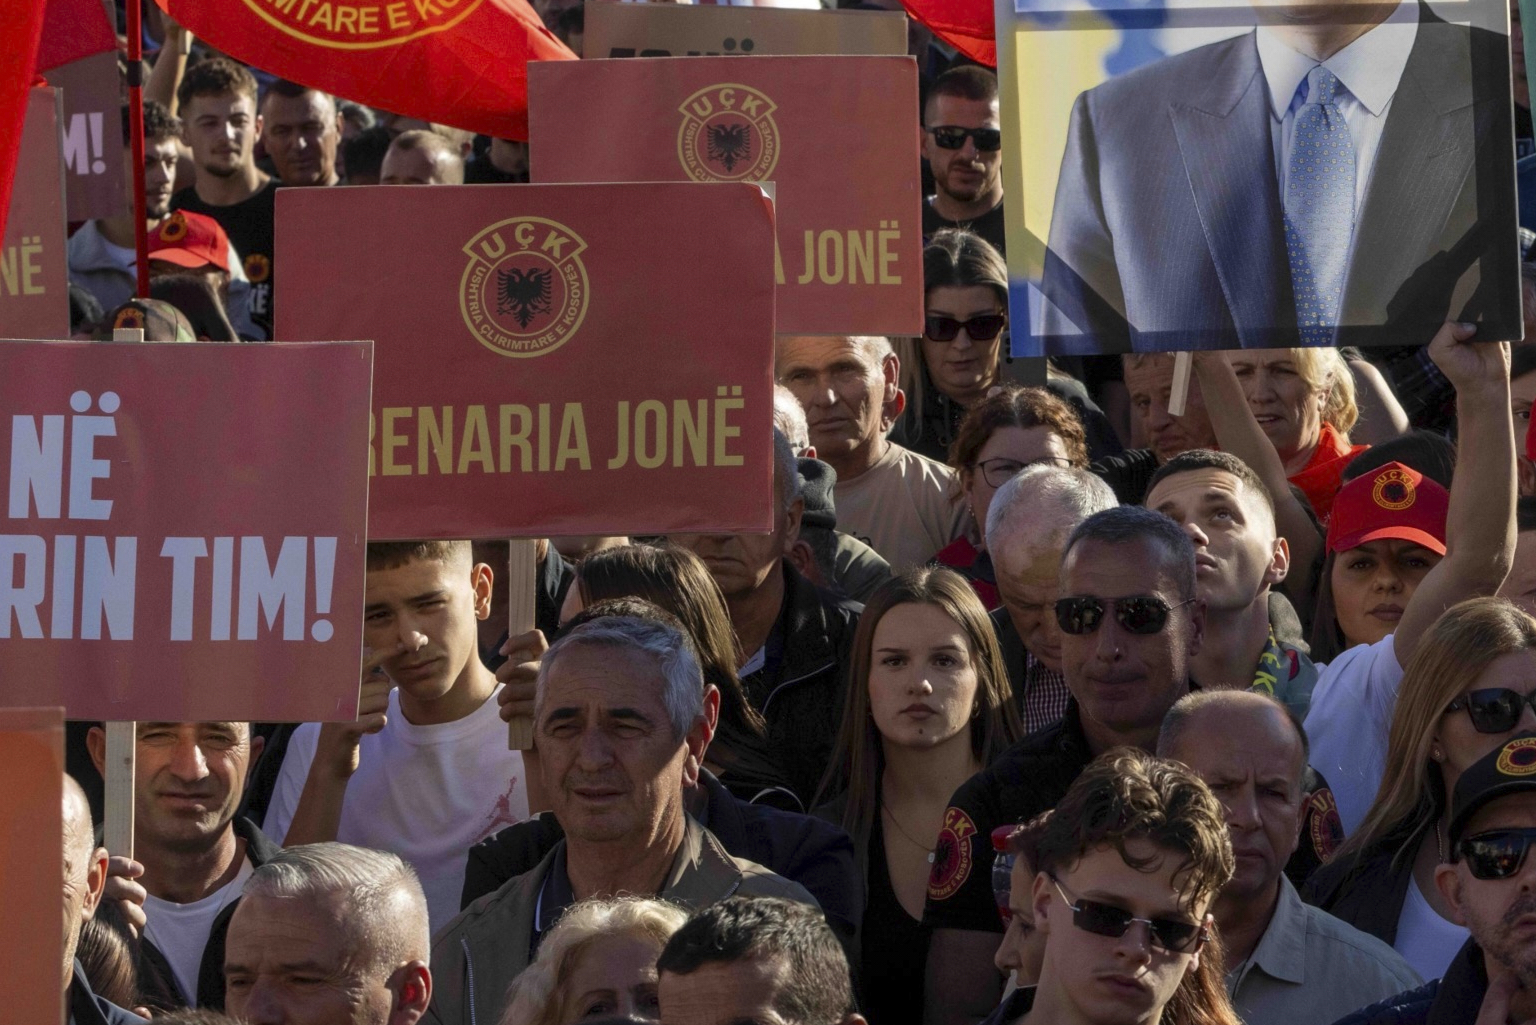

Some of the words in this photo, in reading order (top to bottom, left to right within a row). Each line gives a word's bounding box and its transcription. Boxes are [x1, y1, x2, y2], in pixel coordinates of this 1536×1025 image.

[387, 1, 411, 30] E
[692, 88, 763, 118] UÇK
[480, 222, 571, 259] UÇK
[798, 220, 902, 285] JONË
[468, 266, 487, 325] USHTRIA
[479, 324, 556, 350] ÇLIRIMTARE
[557, 324, 566, 336] E
[563, 263, 581, 325] KOSOVËS
[8, 390, 121, 520] NË
[370, 402, 592, 476] ENARIA
[608, 385, 745, 470] JONË
[0, 534, 138, 641] RIN
[159, 535, 338, 643] TIM!
